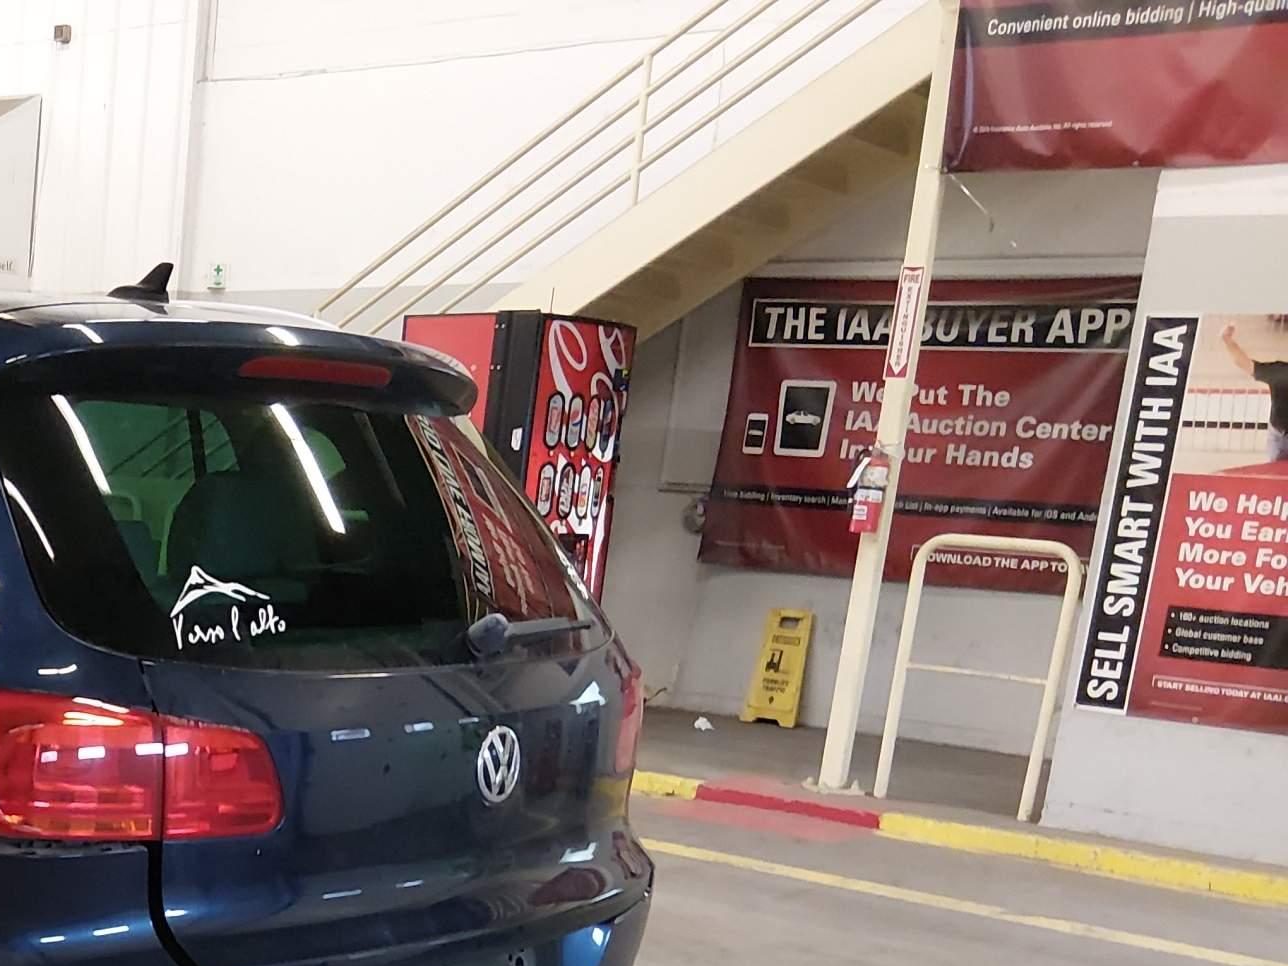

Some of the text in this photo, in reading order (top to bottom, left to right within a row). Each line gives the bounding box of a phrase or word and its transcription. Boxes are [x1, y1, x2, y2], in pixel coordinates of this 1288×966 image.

[987, 14, 1068, 36] Convenient
[1072, 10, 1121, 29] online
[1125, 4, 1183, 26] bidding
[904, 273, 920, 283] FIRE
[764, 307, 828, 340] THE
[1045, 307, 1132, 345] APP
[958, 383, 1011, 408] The
[844, 410, 1113, 442] IA Auction Center
[945, 443, 1035, 469] Hands
[992, 506, 1029, 518] Available
[1031, 508, 1042, 519] for
[1059, 510, 1076, 521] and
[1087, 324, 1188, 701] SELL SMART WITH IAA
[1189, 490, 1228, 513] We
[1185, 516, 1233, 540] You
[926, 552, 992, 567] OWNLOAD
[993, 556, 1019, 569] THE
[1020, 558, 1049, 571] APP
[1178, 541, 1247, 567] More
[1175, 567, 1235, 592] Your
[1199, 614, 1230, 625] auction
[1231, 617, 1270, 629] locations
[1175, 627, 1264, 645] Global customer base
[1172, 642, 1253, 662] Competitive bidding
[1157, 679, 1183, 690] START
[1221, 687, 1249, 699] TODAY
[1249, 690, 1261, 700] AT
